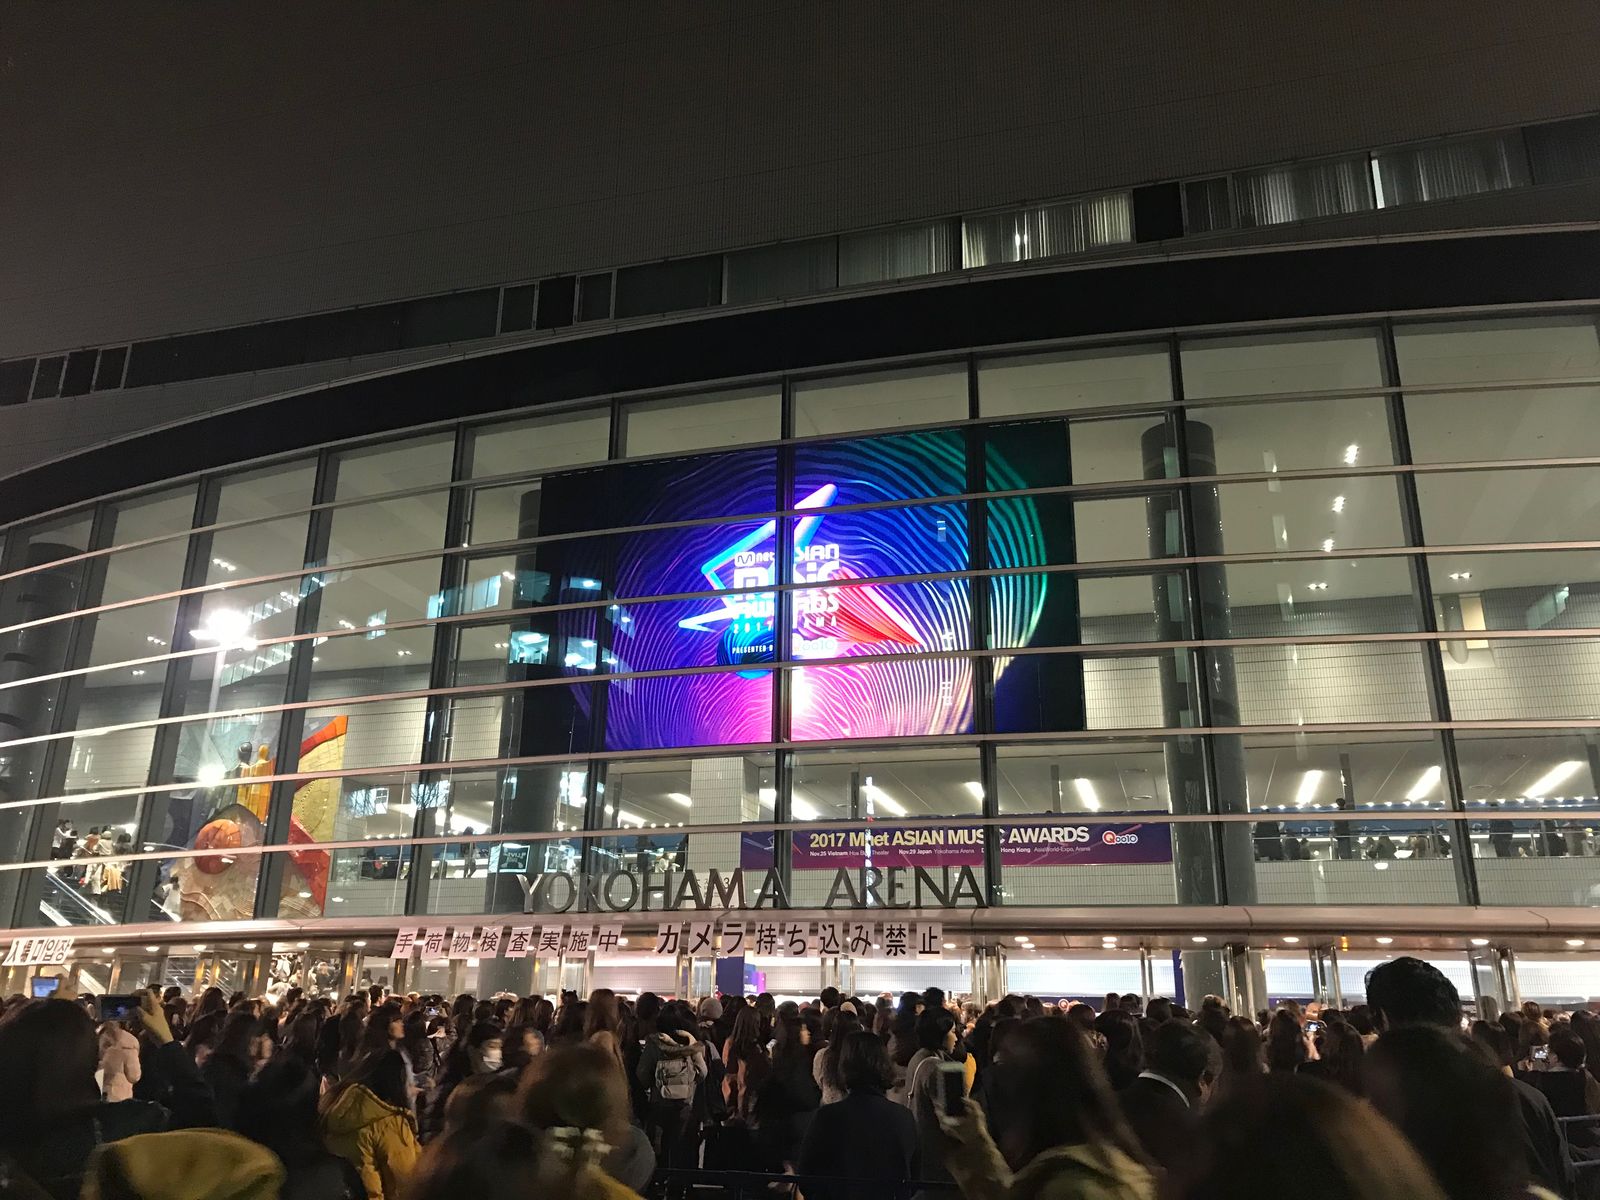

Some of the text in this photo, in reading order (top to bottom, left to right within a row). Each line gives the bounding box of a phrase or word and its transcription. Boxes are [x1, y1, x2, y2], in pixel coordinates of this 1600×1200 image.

[809, 832, 845, 848] 2017
[891, 830, 944, 846] ASIAN
[1008, 826, 1090, 843] AWARDS
[516, 867, 791, 914] YOKOHAMA
[825, 864, 988, 910] ARENA
[395, 928, 621, 955] 手荷物検査実施中
[656, 921, 942, 956] カメラ持ち込み禁止
